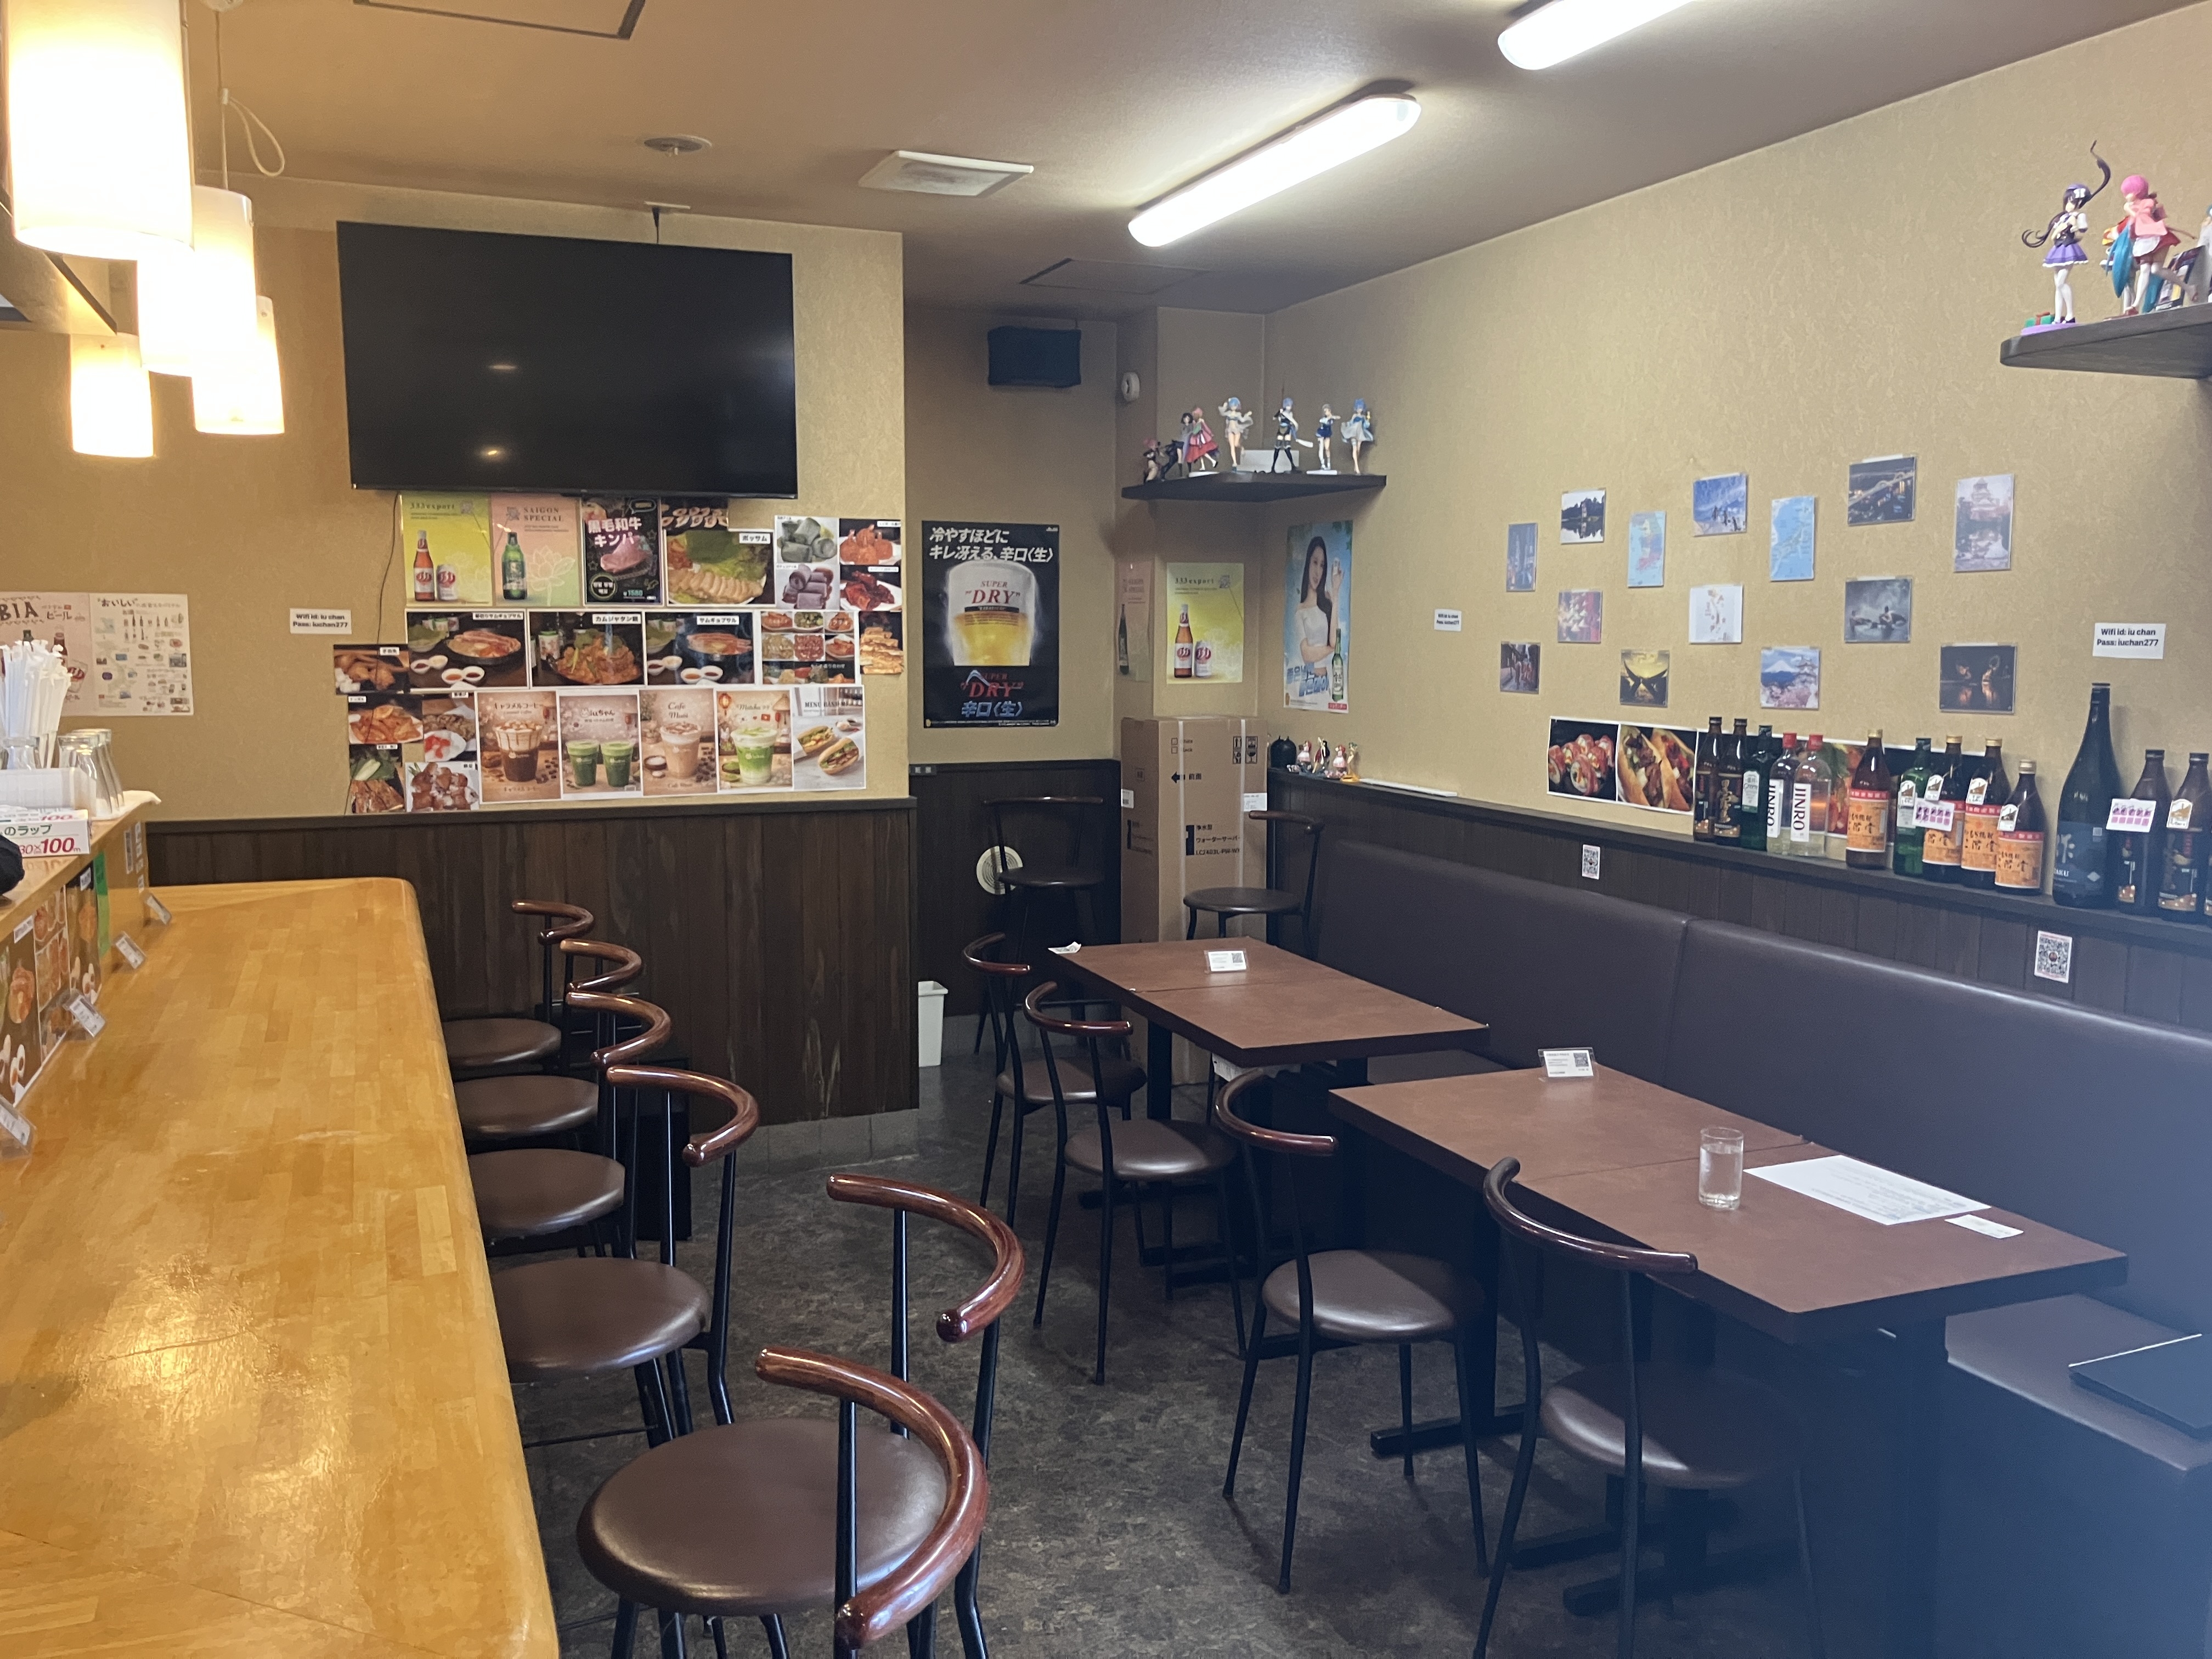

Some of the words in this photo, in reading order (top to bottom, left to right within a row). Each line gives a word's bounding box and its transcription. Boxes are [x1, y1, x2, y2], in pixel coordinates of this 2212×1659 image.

[588, 517, 642, 533] 黒毛和牛
[595, 532, 634, 547] キンパ
[929, 527, 1010, 543] 冷やすほどに
[1767, 785, 1776, 826] JINRO
[1793, 788, 1806, 831] JINRO
[0, 824, 53, 836] のラップ
